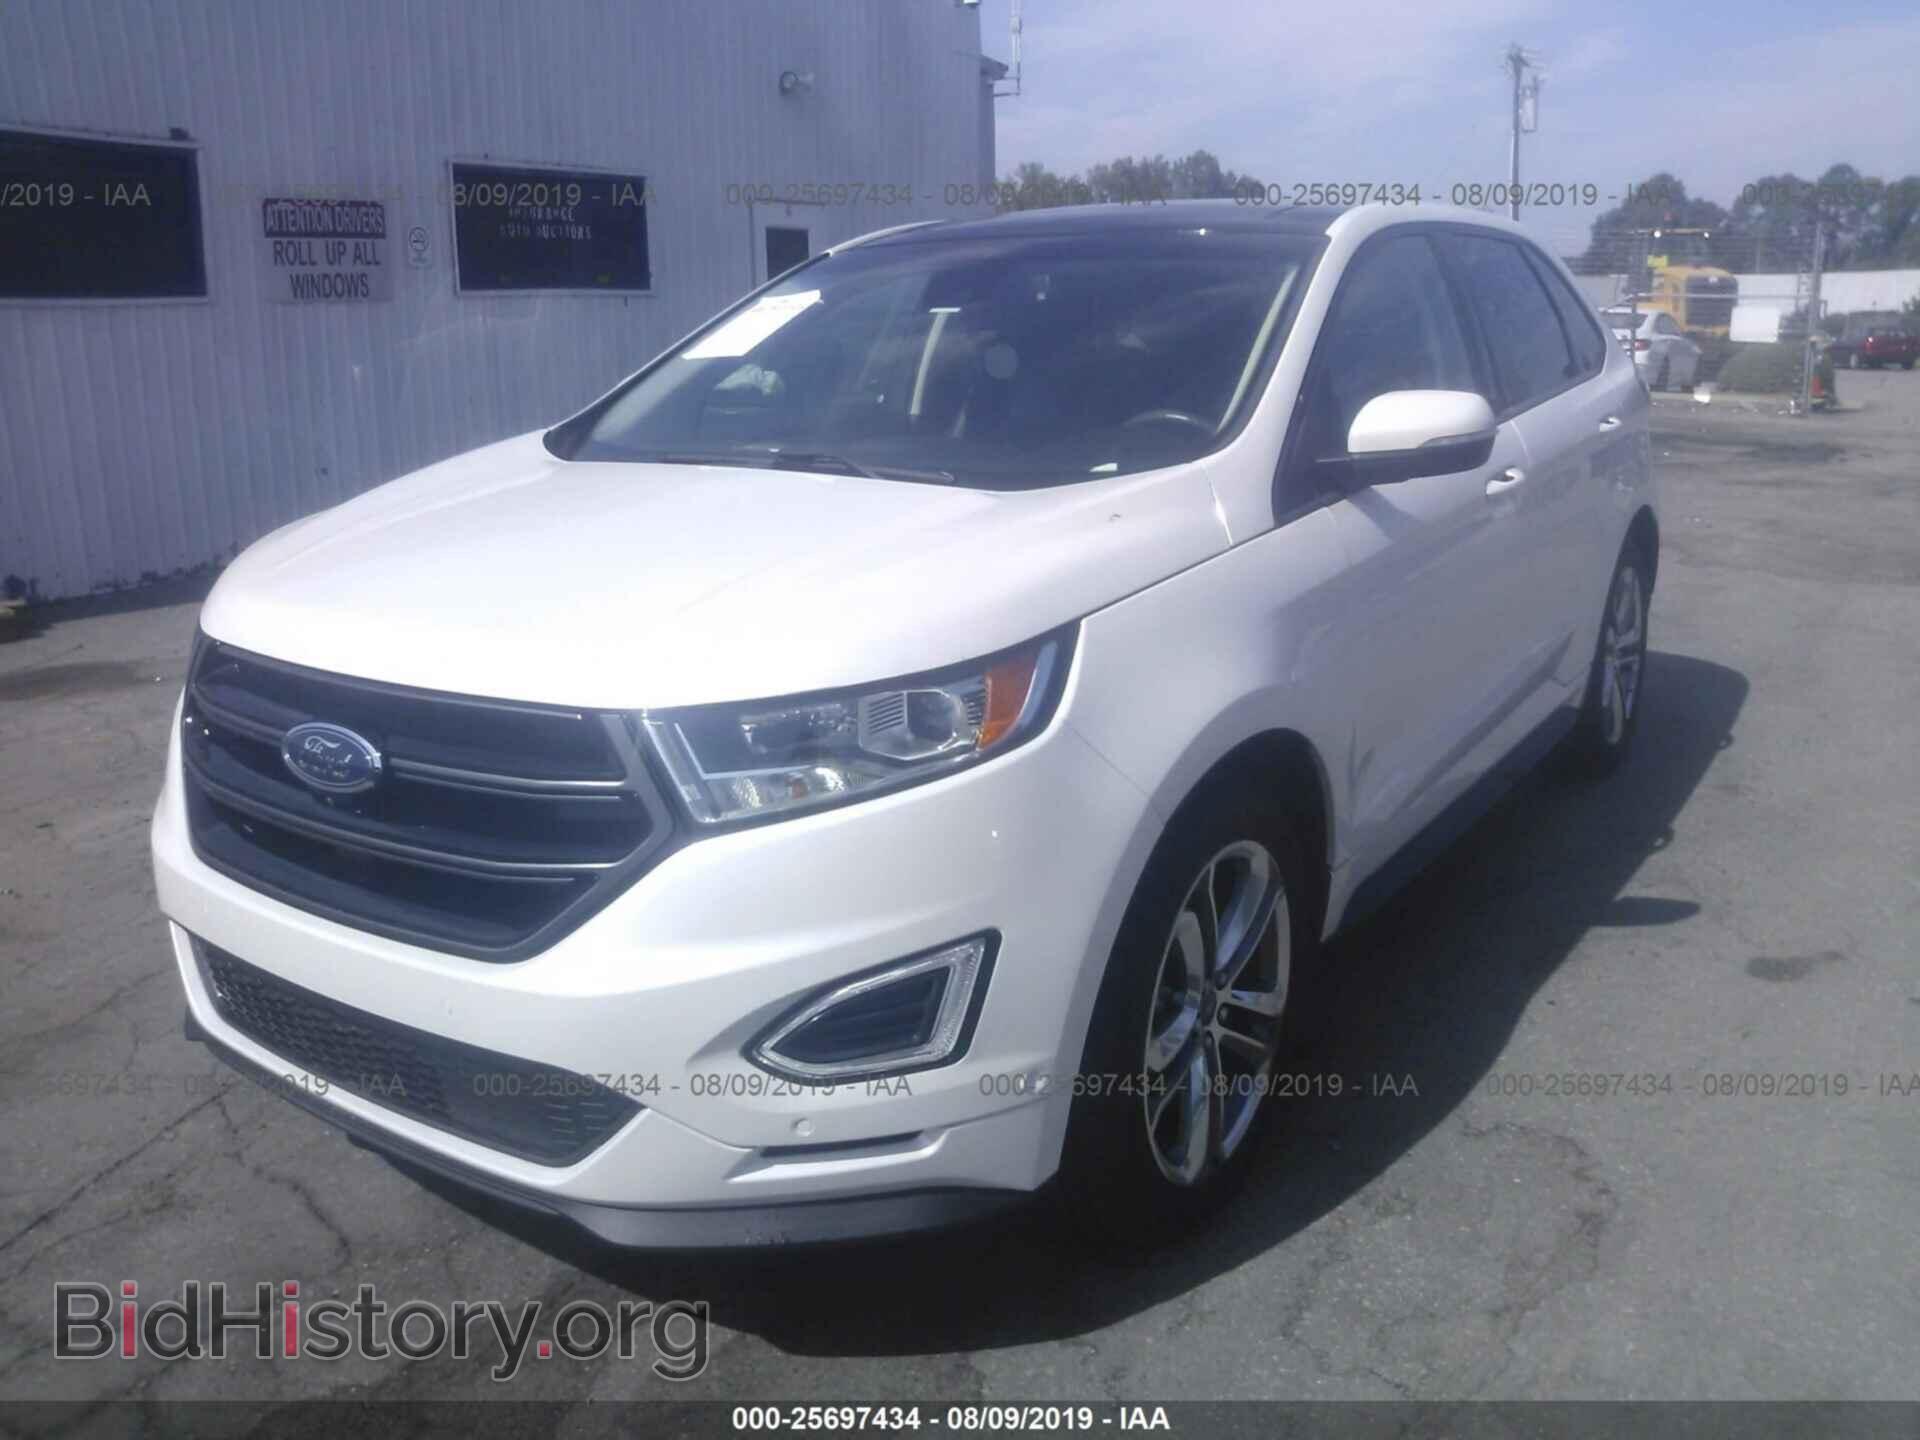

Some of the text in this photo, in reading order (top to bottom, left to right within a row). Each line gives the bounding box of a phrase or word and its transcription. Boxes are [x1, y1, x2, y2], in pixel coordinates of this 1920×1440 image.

[266, 204, 384, 233] ATTENTION DRIVERS
[273, 240, 382, 266] ROLL UP ALL
[289, 271, 370, 299] WINDOWS
